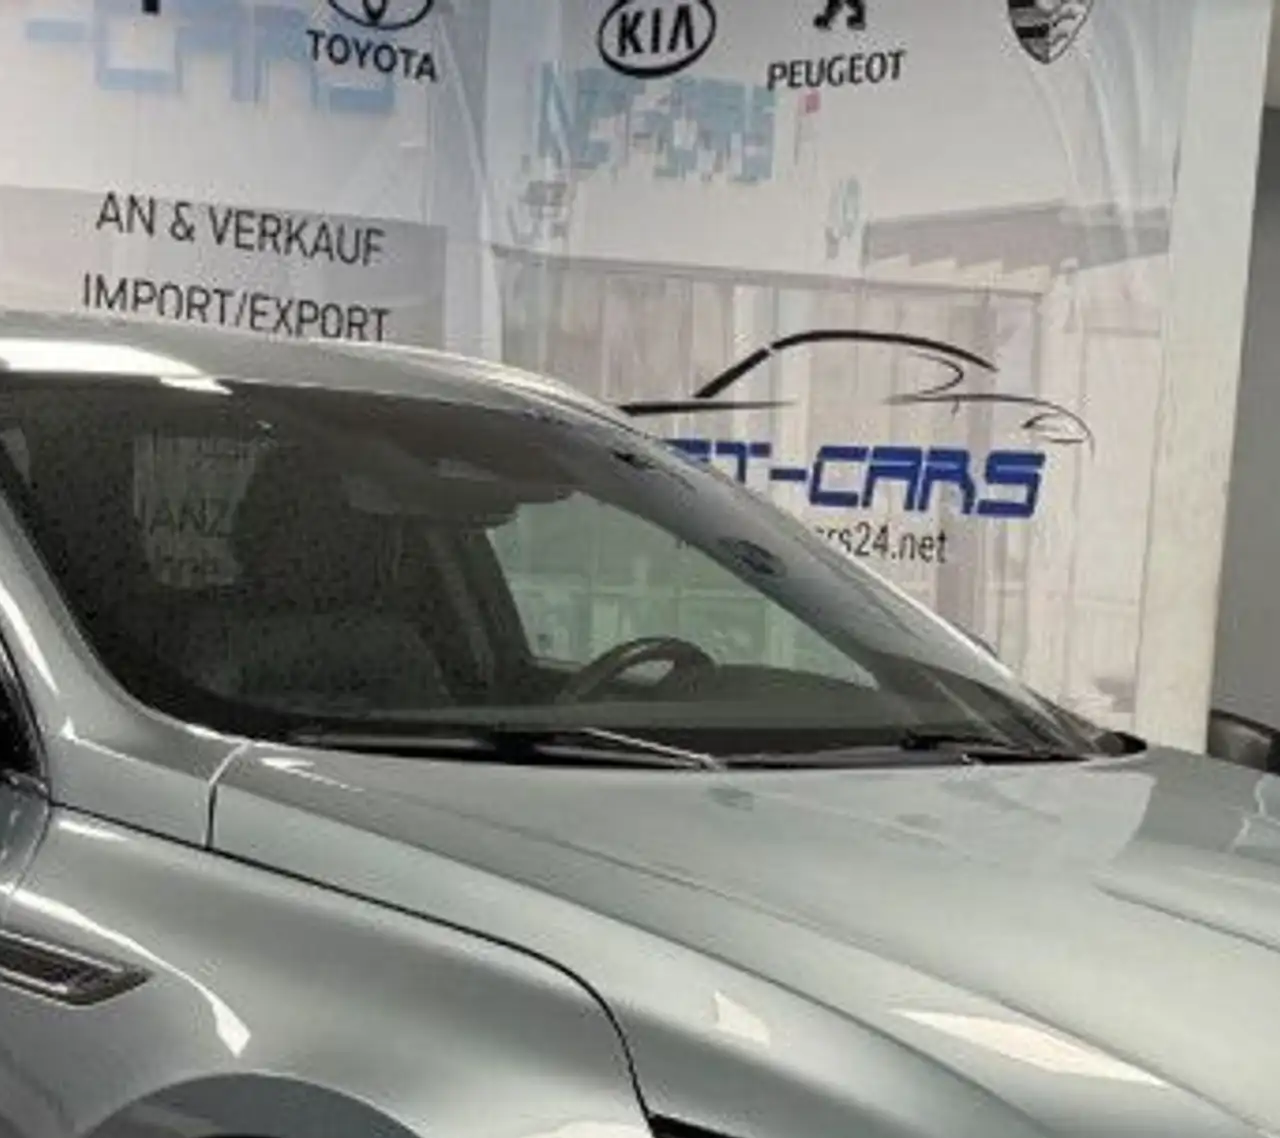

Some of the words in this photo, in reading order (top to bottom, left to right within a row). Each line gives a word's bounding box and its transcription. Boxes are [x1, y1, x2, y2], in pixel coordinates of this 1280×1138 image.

[307, 28, 439, 83] TOYOTA
[619, 3, 697, 57] KIA
[767, 49, 908, 91] PEUGEOT
[95, 190, 156, 238] AN
[169, 201, 197, 244] &
[208, 204, 388, 267] VERKAUF
[81, 271, 393, 342] IMPORT/EXPORT
